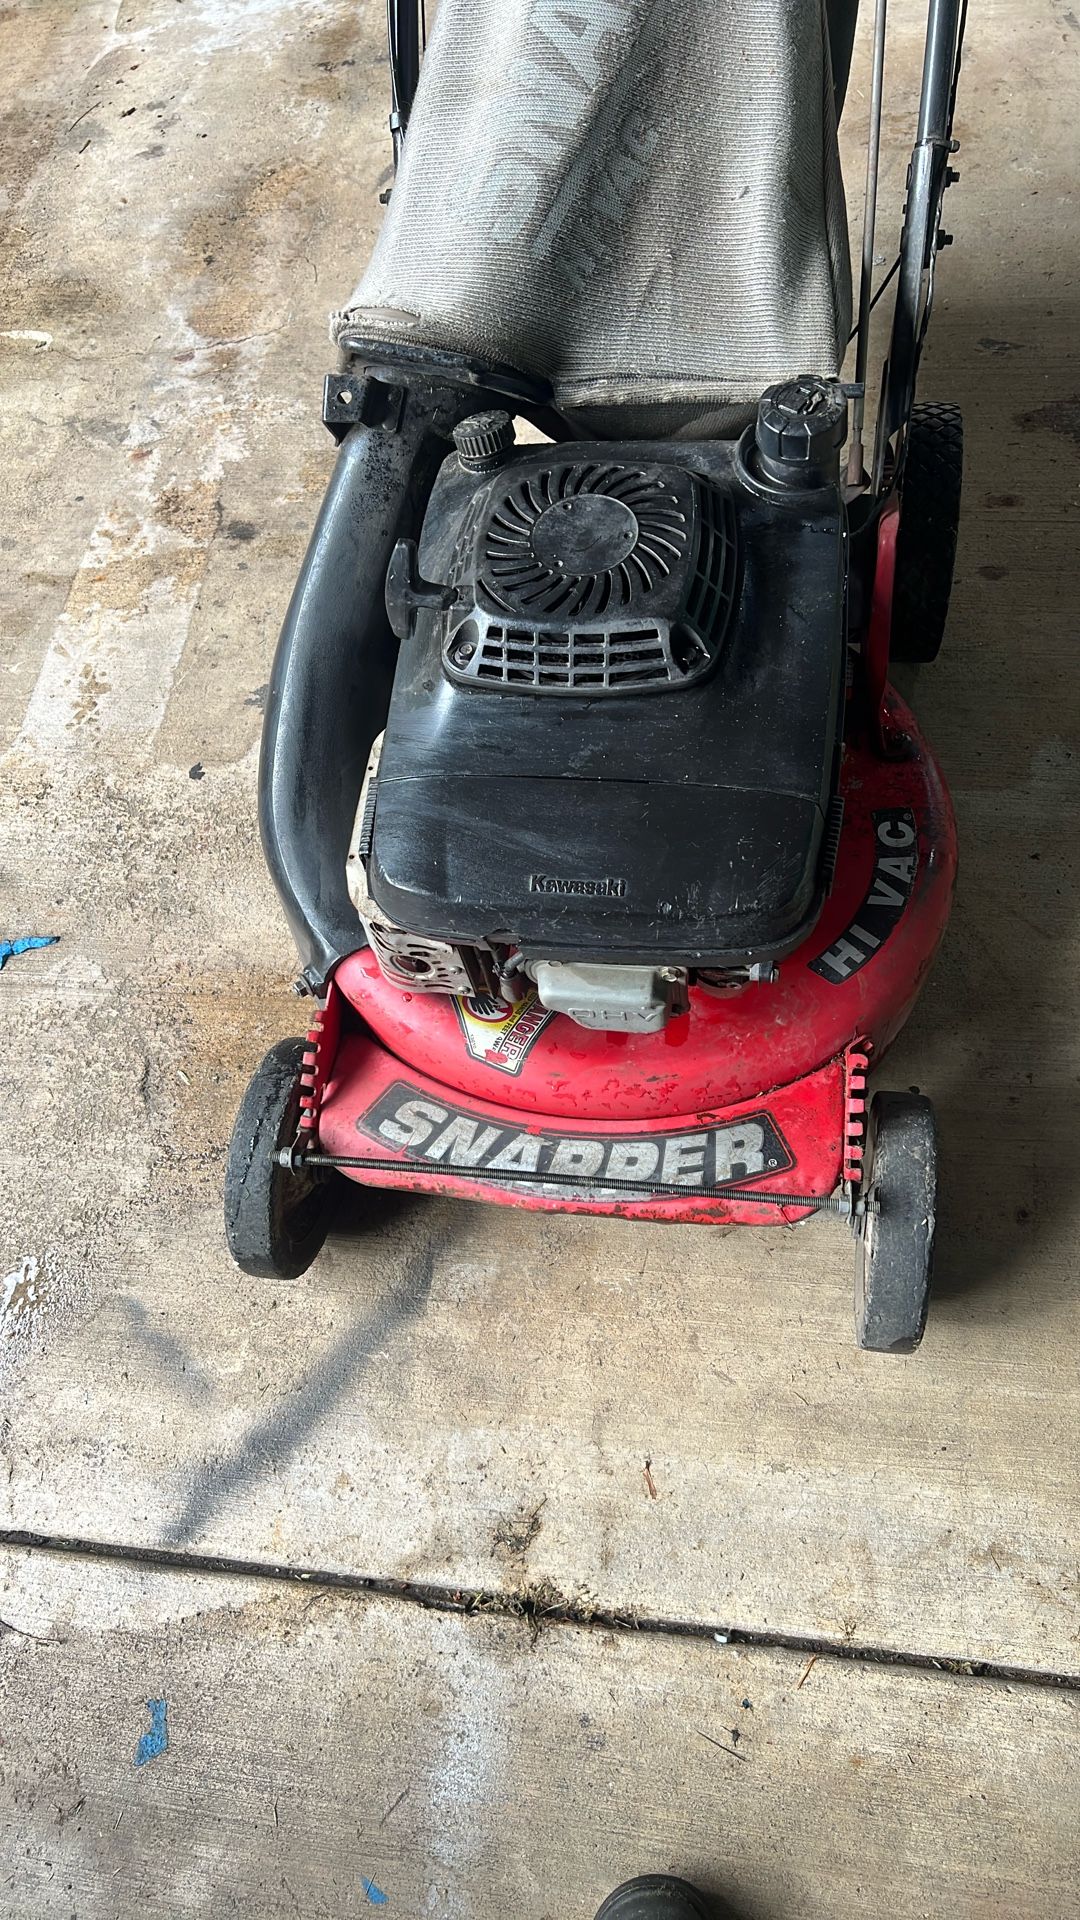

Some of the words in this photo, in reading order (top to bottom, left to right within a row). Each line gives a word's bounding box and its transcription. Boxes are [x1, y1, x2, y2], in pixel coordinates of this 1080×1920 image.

[529, 874, 627, 897] Kawasaki
[820, 923, 881, 977] HI
[501, 998, 550, 1061] ANGER
[568, 1007, 658, 1022] OHV
[378, 1100, 766, 1195] SNAPPER
